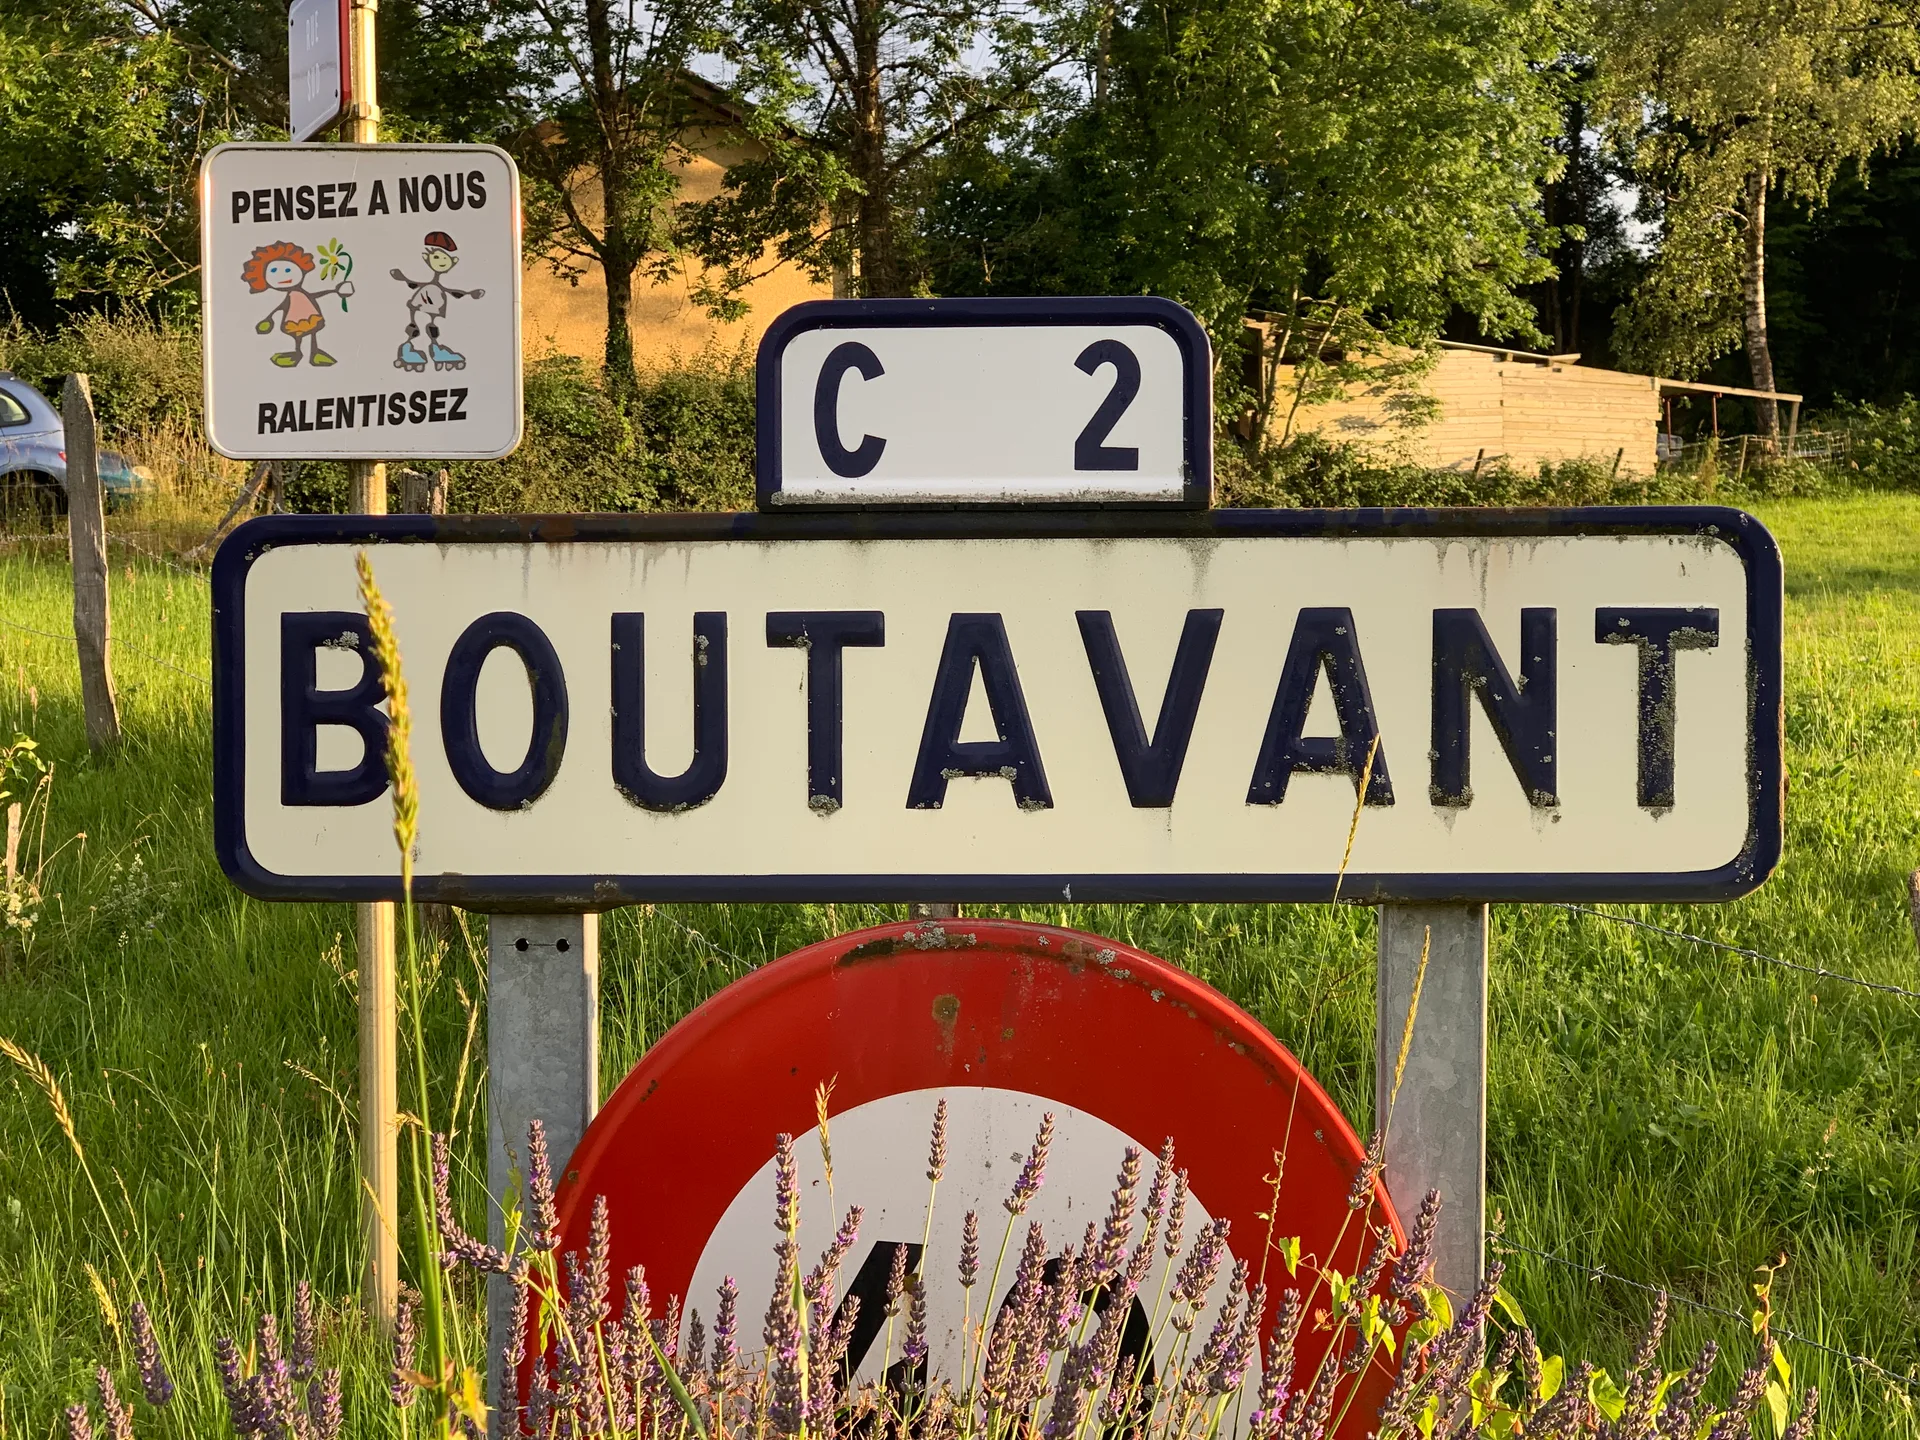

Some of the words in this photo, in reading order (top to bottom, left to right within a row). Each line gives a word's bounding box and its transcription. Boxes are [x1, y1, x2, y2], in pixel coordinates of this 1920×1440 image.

[232, 182, 358, 224] PENSEZ
[367, 180, 390, 215] A
[399, 170, 487, 214] NOUS
[258, 387, 468, 435] RALENTISSEZ
[814, 341, 887, 478] C
[1074, 339, 1141, 471] 2
[281, 607, 1720, 813] BOUTAVANT
